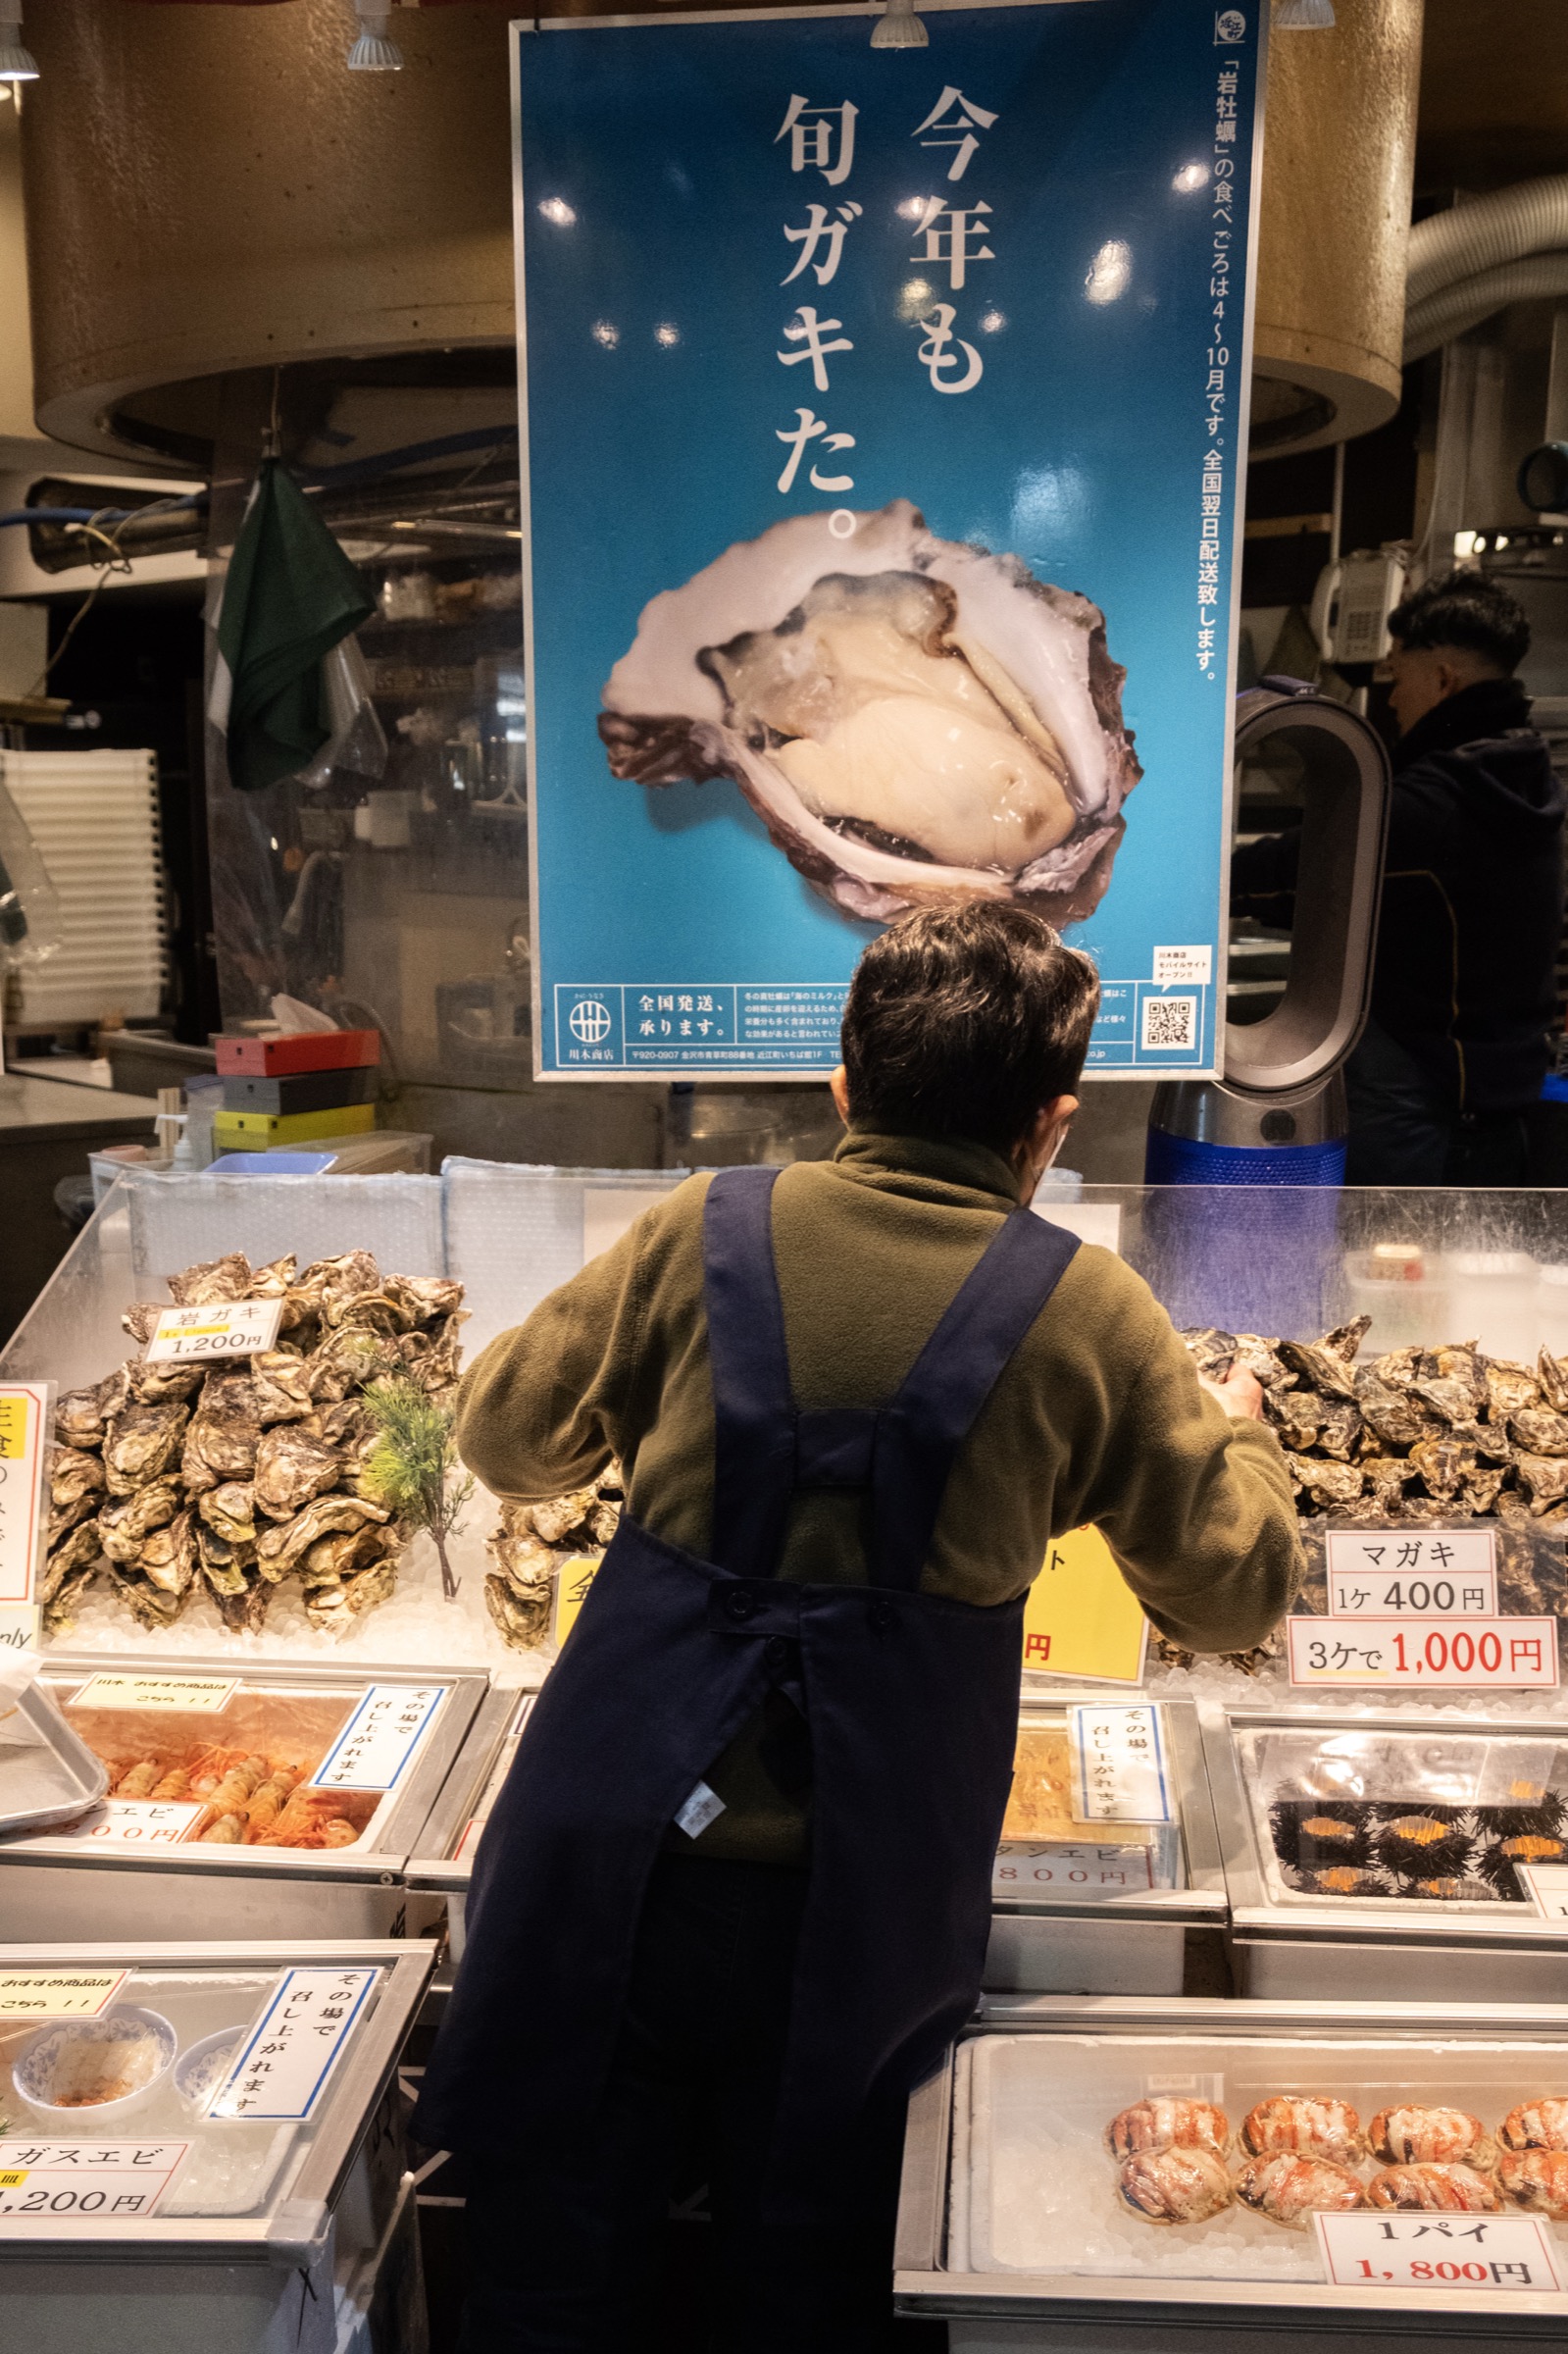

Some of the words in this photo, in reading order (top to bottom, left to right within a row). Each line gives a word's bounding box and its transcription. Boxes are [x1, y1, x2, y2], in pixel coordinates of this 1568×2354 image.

[910, 85, 1000, 394] 今年も
[773, 94, 863, 539] 旬ガキた。
[638, 995, 724, 1012] 全国発送、
[638, 1019, 724, 1037] 承ります。
[569, 1049, 614, 1060] 川木商店
[177, 1305, 262, 1326] 岩ガキ
[172, 1333, 263, 1354] 1,200円
[1362, 1540, 1455, 1568] マガキ
[1025, 1633, 1052, 1662] 円
[1392, 1632, 1543, 1673] 1,000円
[134, 1680, 228, 1690] おすすめ商品は
[394, 1691, 430, 1734] その場で
[330, 1701, 392, 1782] 召し上がれます
[1125, 1710, 1149, 1763] その場で
[1090, 1725, 1120, 1816] 召し上がれます
[1, 1978, 114, 1987] おすすめ商品は
[1, 2000, 47, 2009] こちら
[313, 1973, 361, 2036] その場で
[236, 1991, 314, 2112] 召し上がれます
[9, 2146, 165, 2166] ガスエビ
[0, 2190, 146, 2214] ,200円
[1377, 2221, 1489, 2244] 1パイ
[1354, 2258, 1533, 2285] 1,800円
